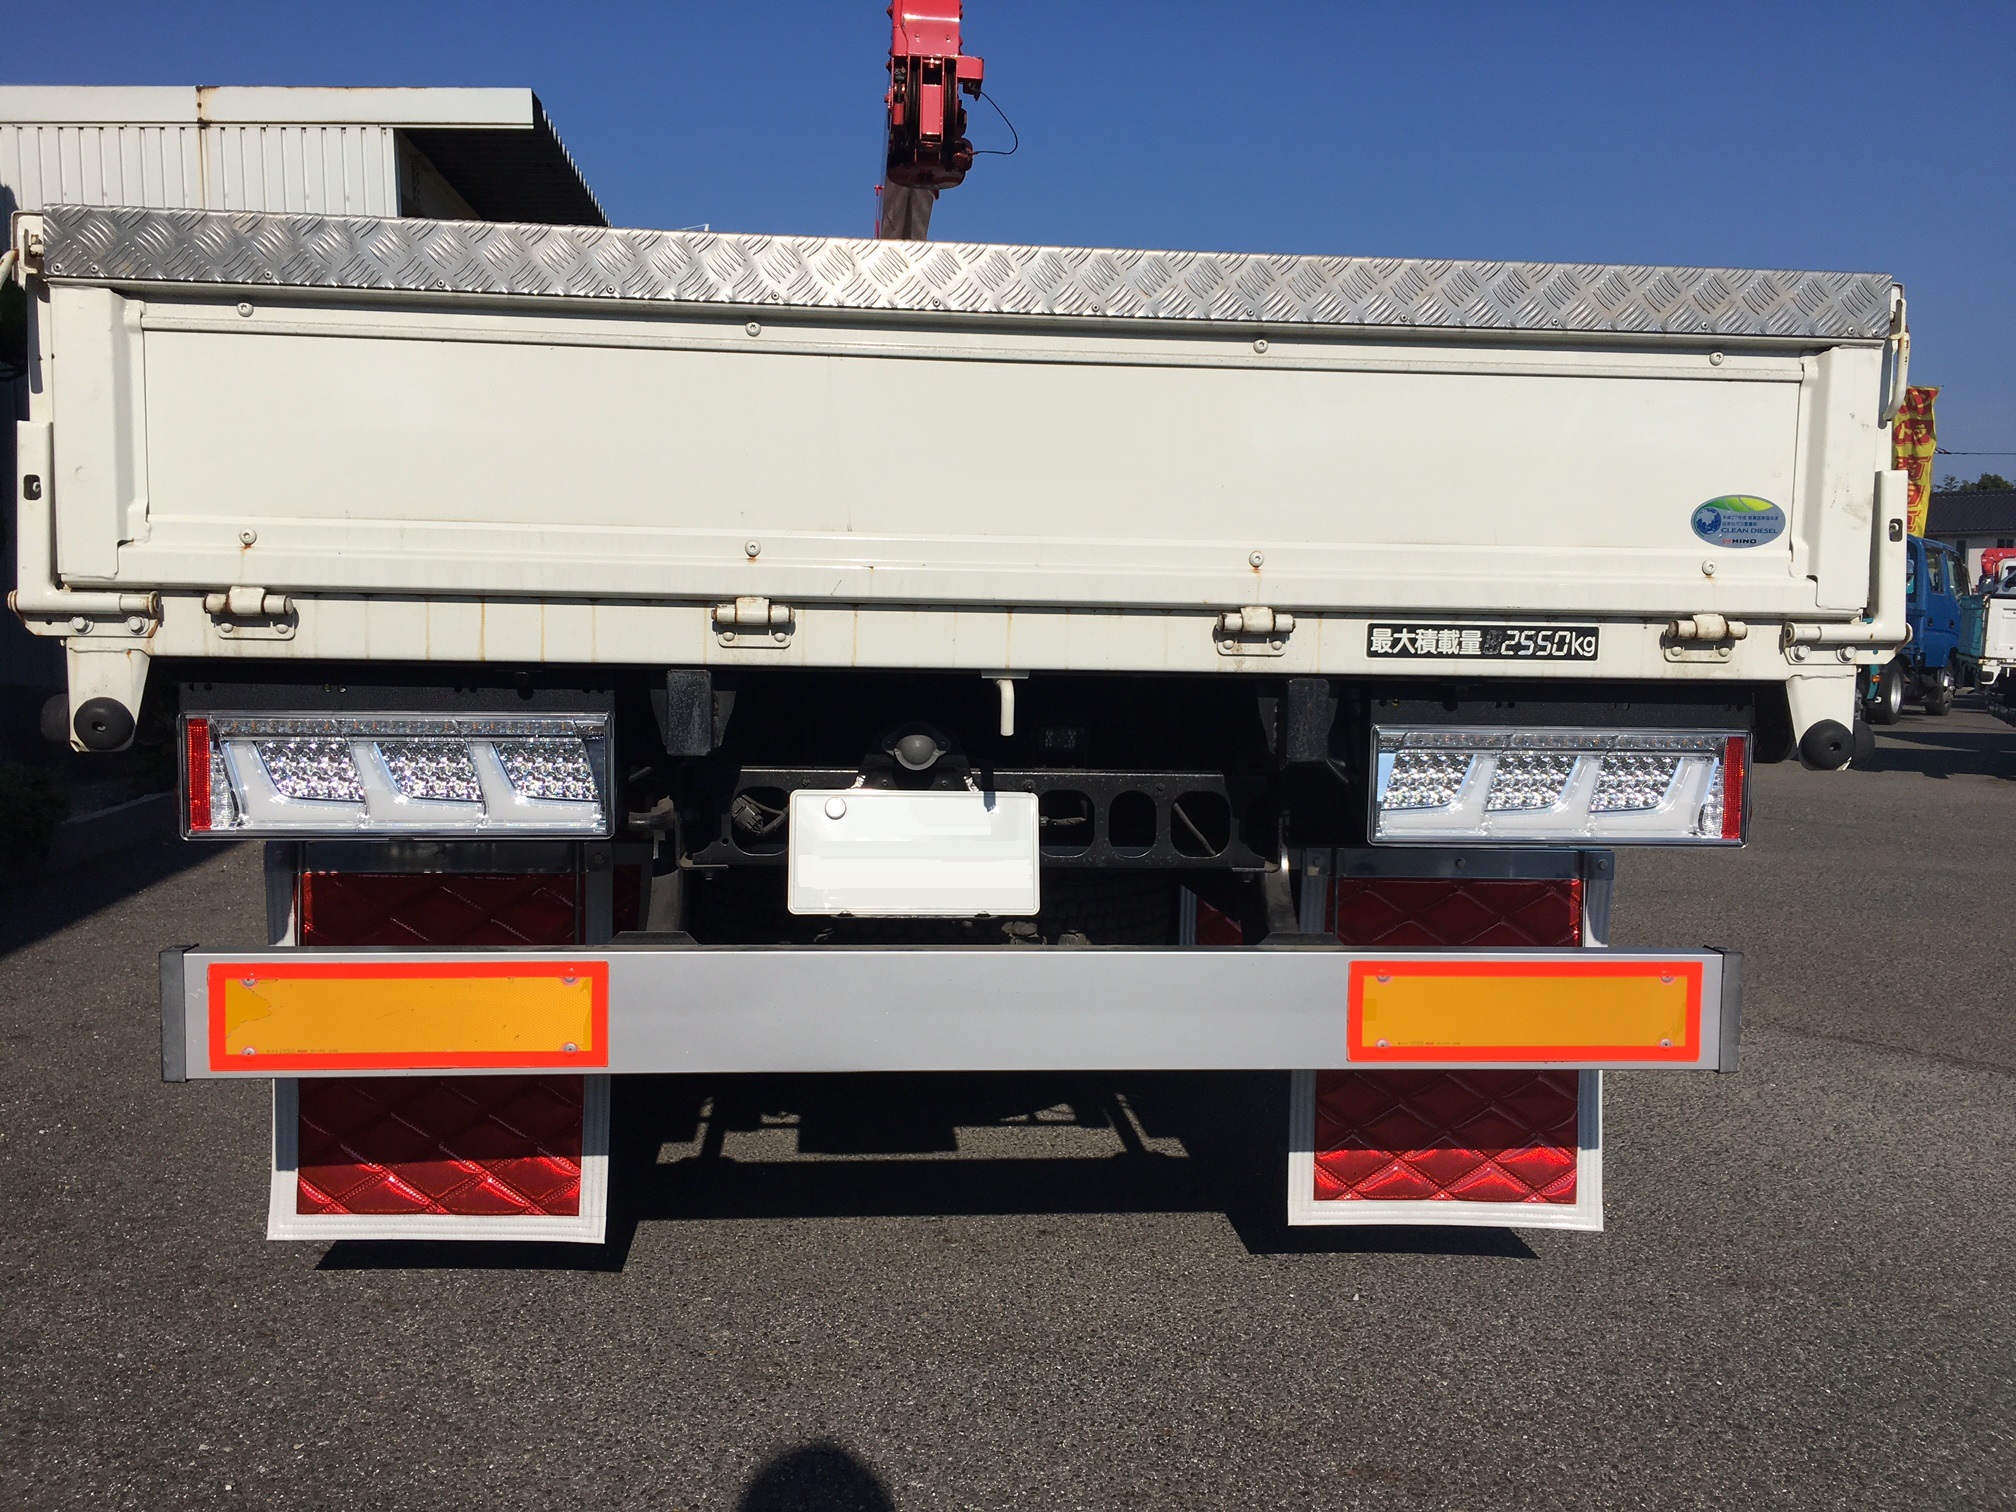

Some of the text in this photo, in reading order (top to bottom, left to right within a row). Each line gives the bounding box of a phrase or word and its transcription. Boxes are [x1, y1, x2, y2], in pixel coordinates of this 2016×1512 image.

[1370, 628, 1596, 657] 最大積載量 2550kg
